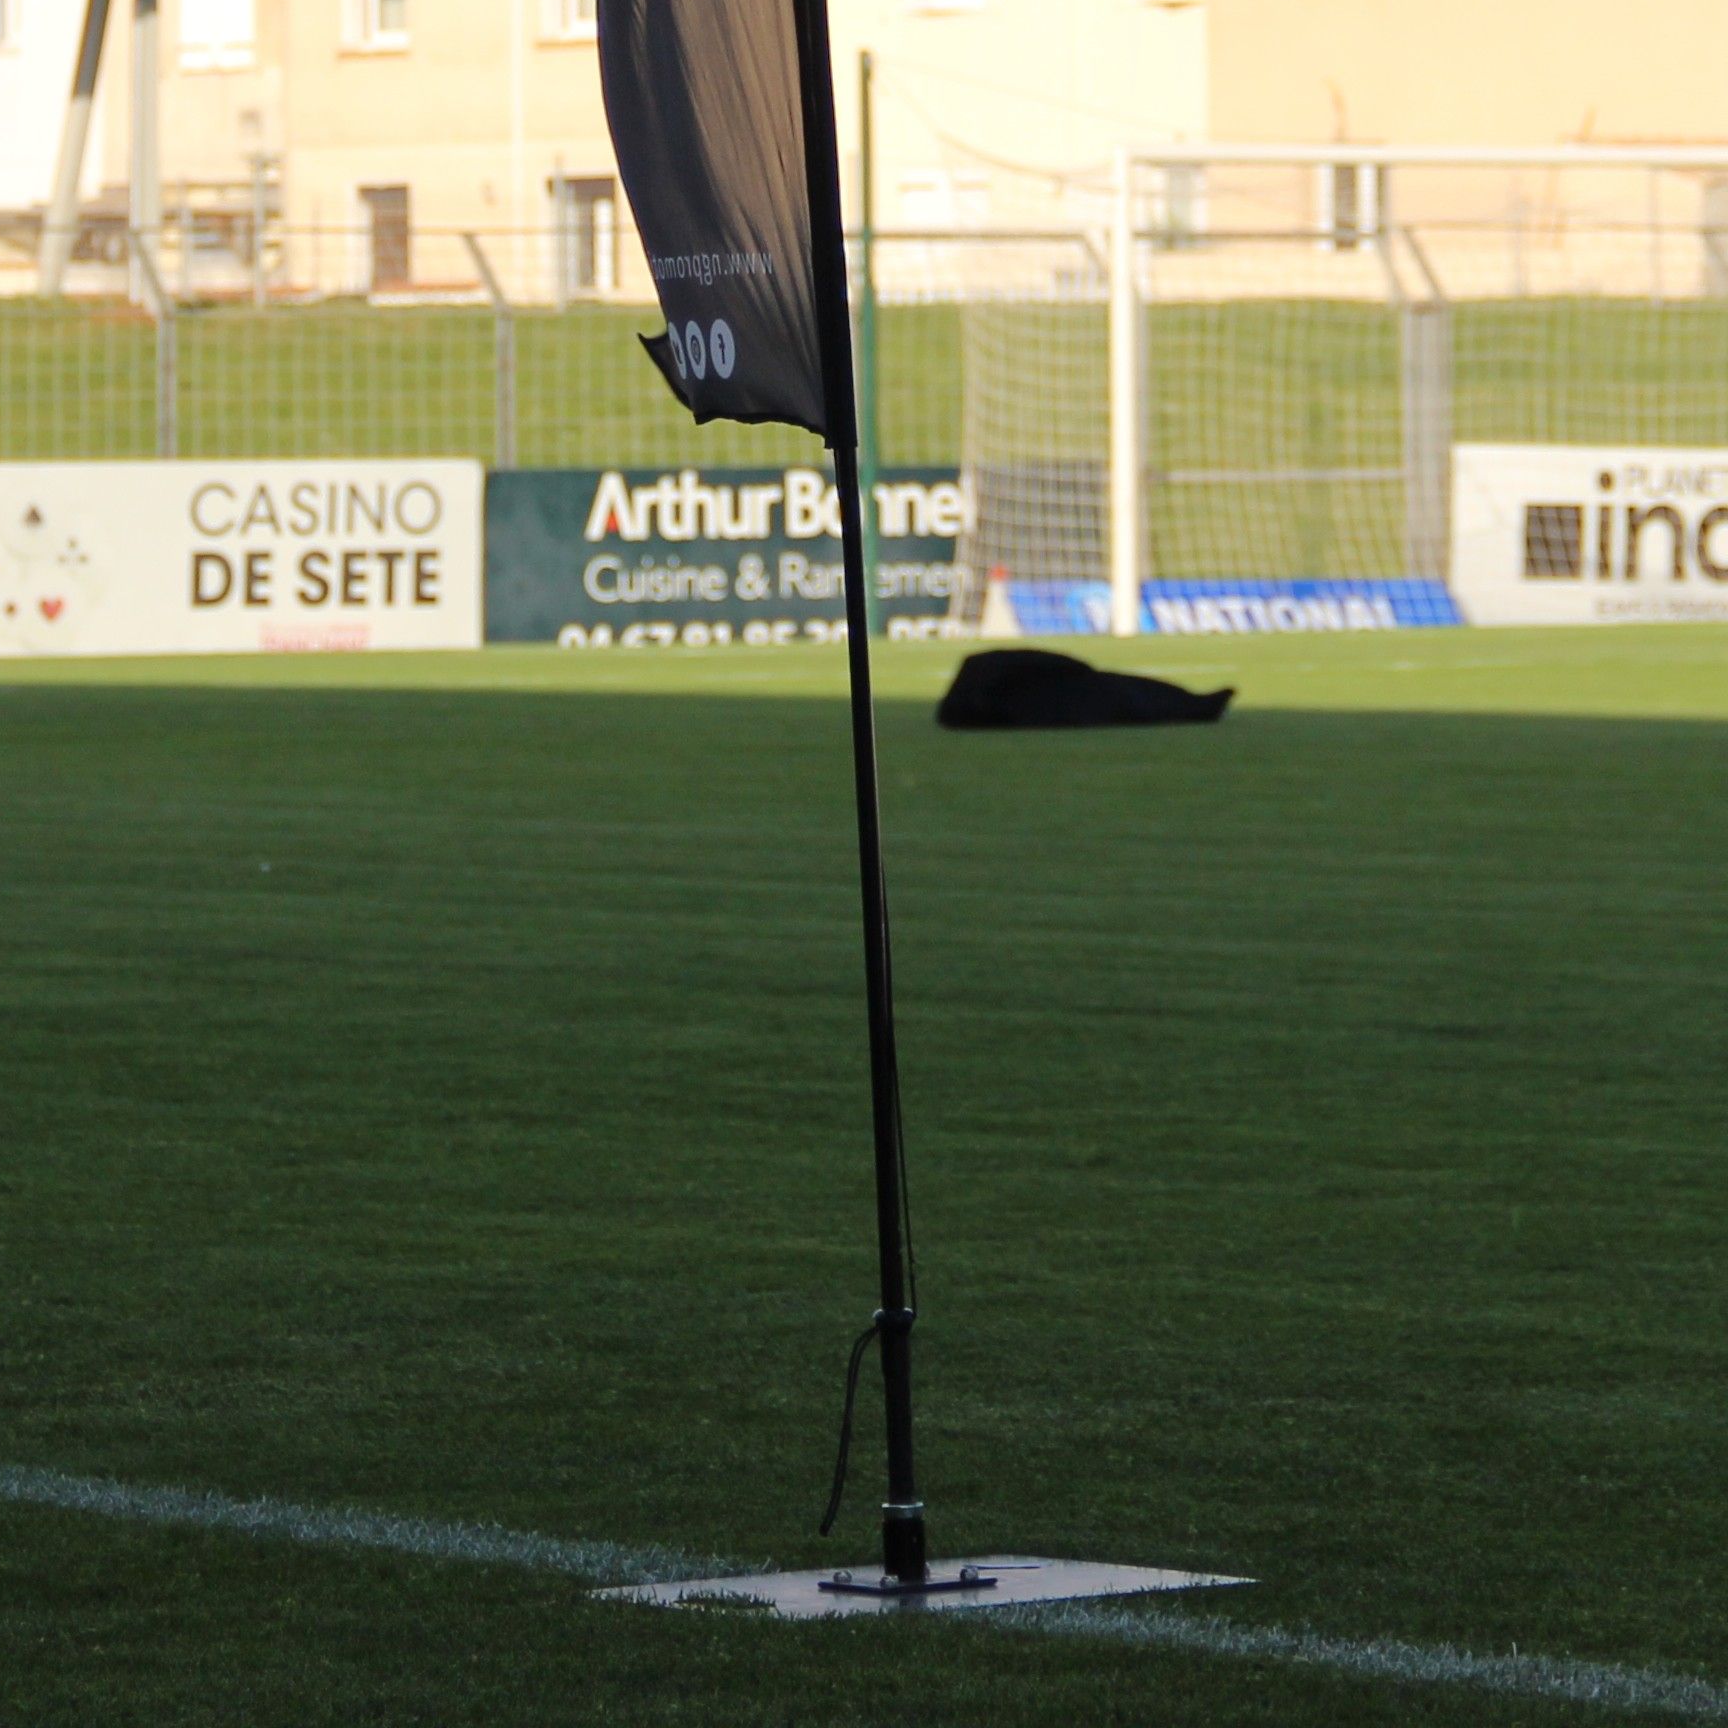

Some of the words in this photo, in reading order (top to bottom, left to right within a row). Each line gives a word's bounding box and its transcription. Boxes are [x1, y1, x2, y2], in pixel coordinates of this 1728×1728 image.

[188, 480, 444, 539] CASINO
[583, 468, 782, 542] Arthur
[189, 550, 274, 608] DE
[295, 550, 441, 608] SETE
[583, 555, 728, 603] Cuisine
[735, 553, 770, 602] &
